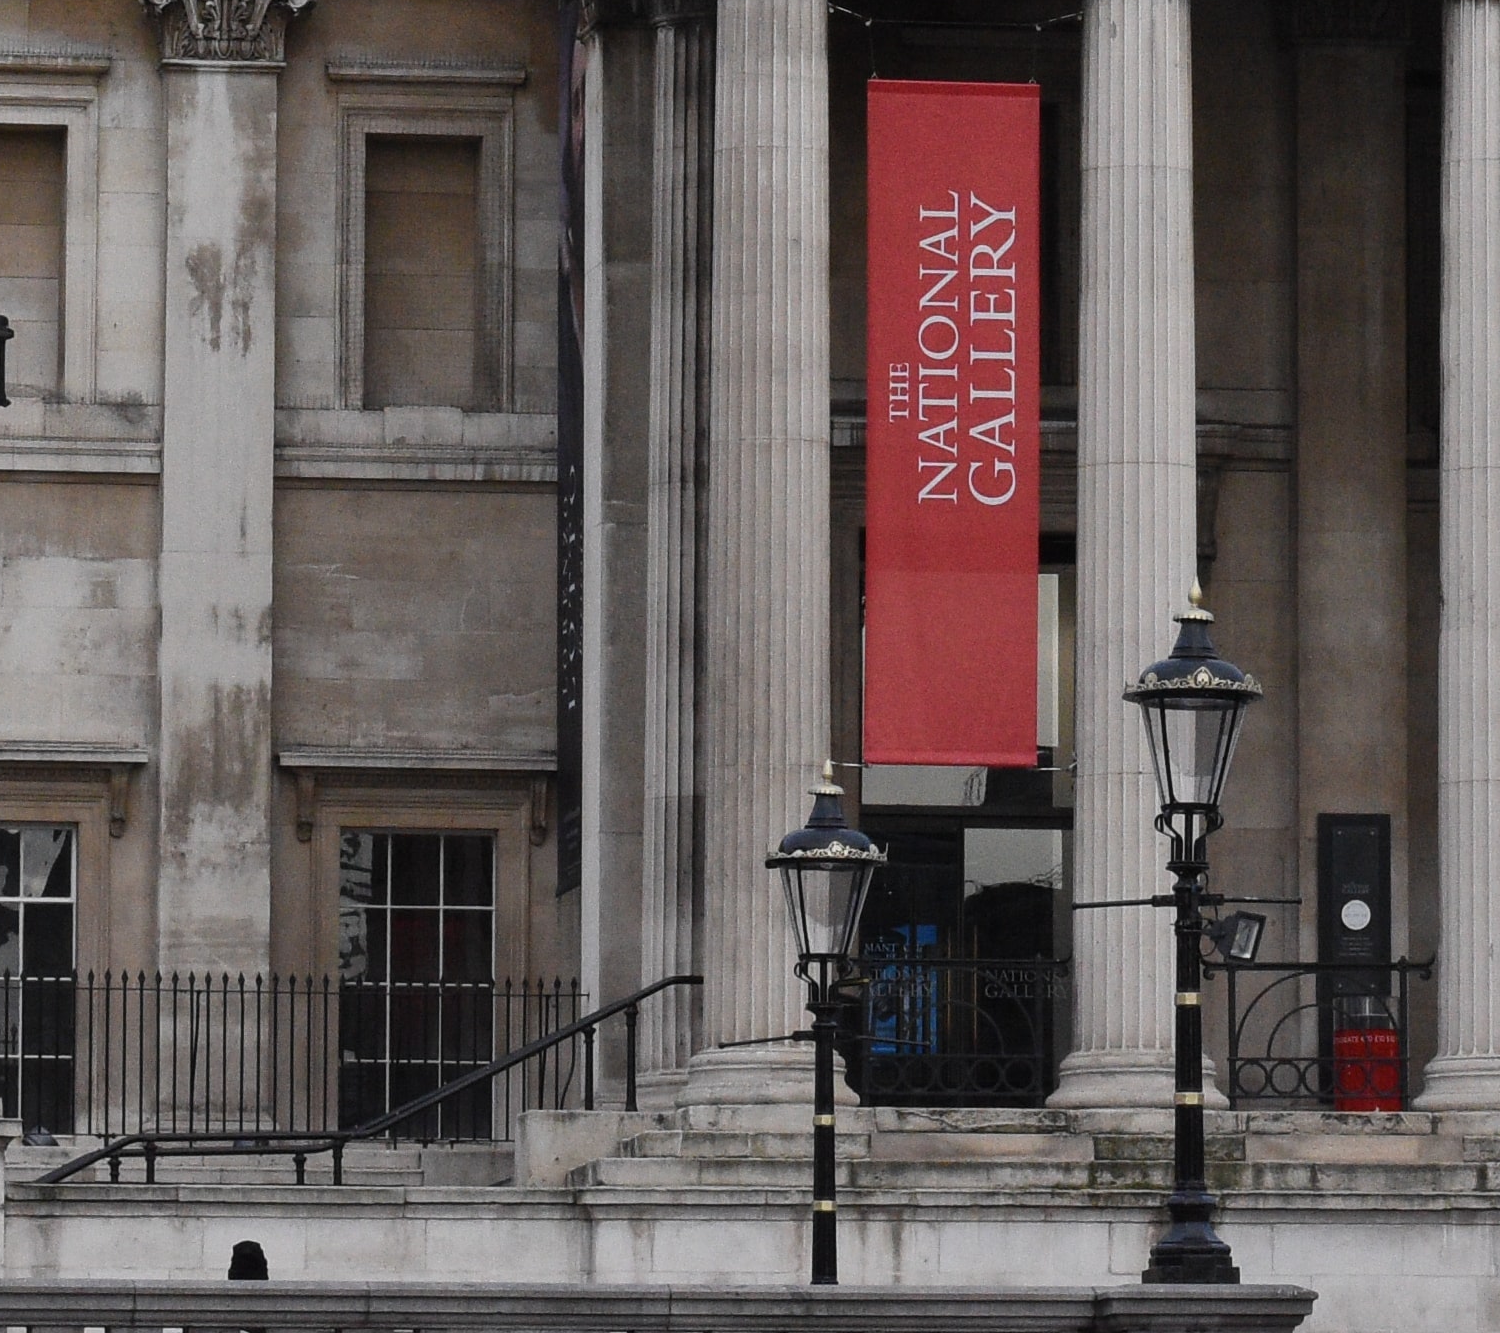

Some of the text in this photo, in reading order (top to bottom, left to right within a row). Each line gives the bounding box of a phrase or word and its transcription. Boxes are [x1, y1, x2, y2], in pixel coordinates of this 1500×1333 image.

[887, 361, 910, 424] THE
[917, 189, 959, 506] NATIONAL
[967, 189, 1016, 507] GALLERY
